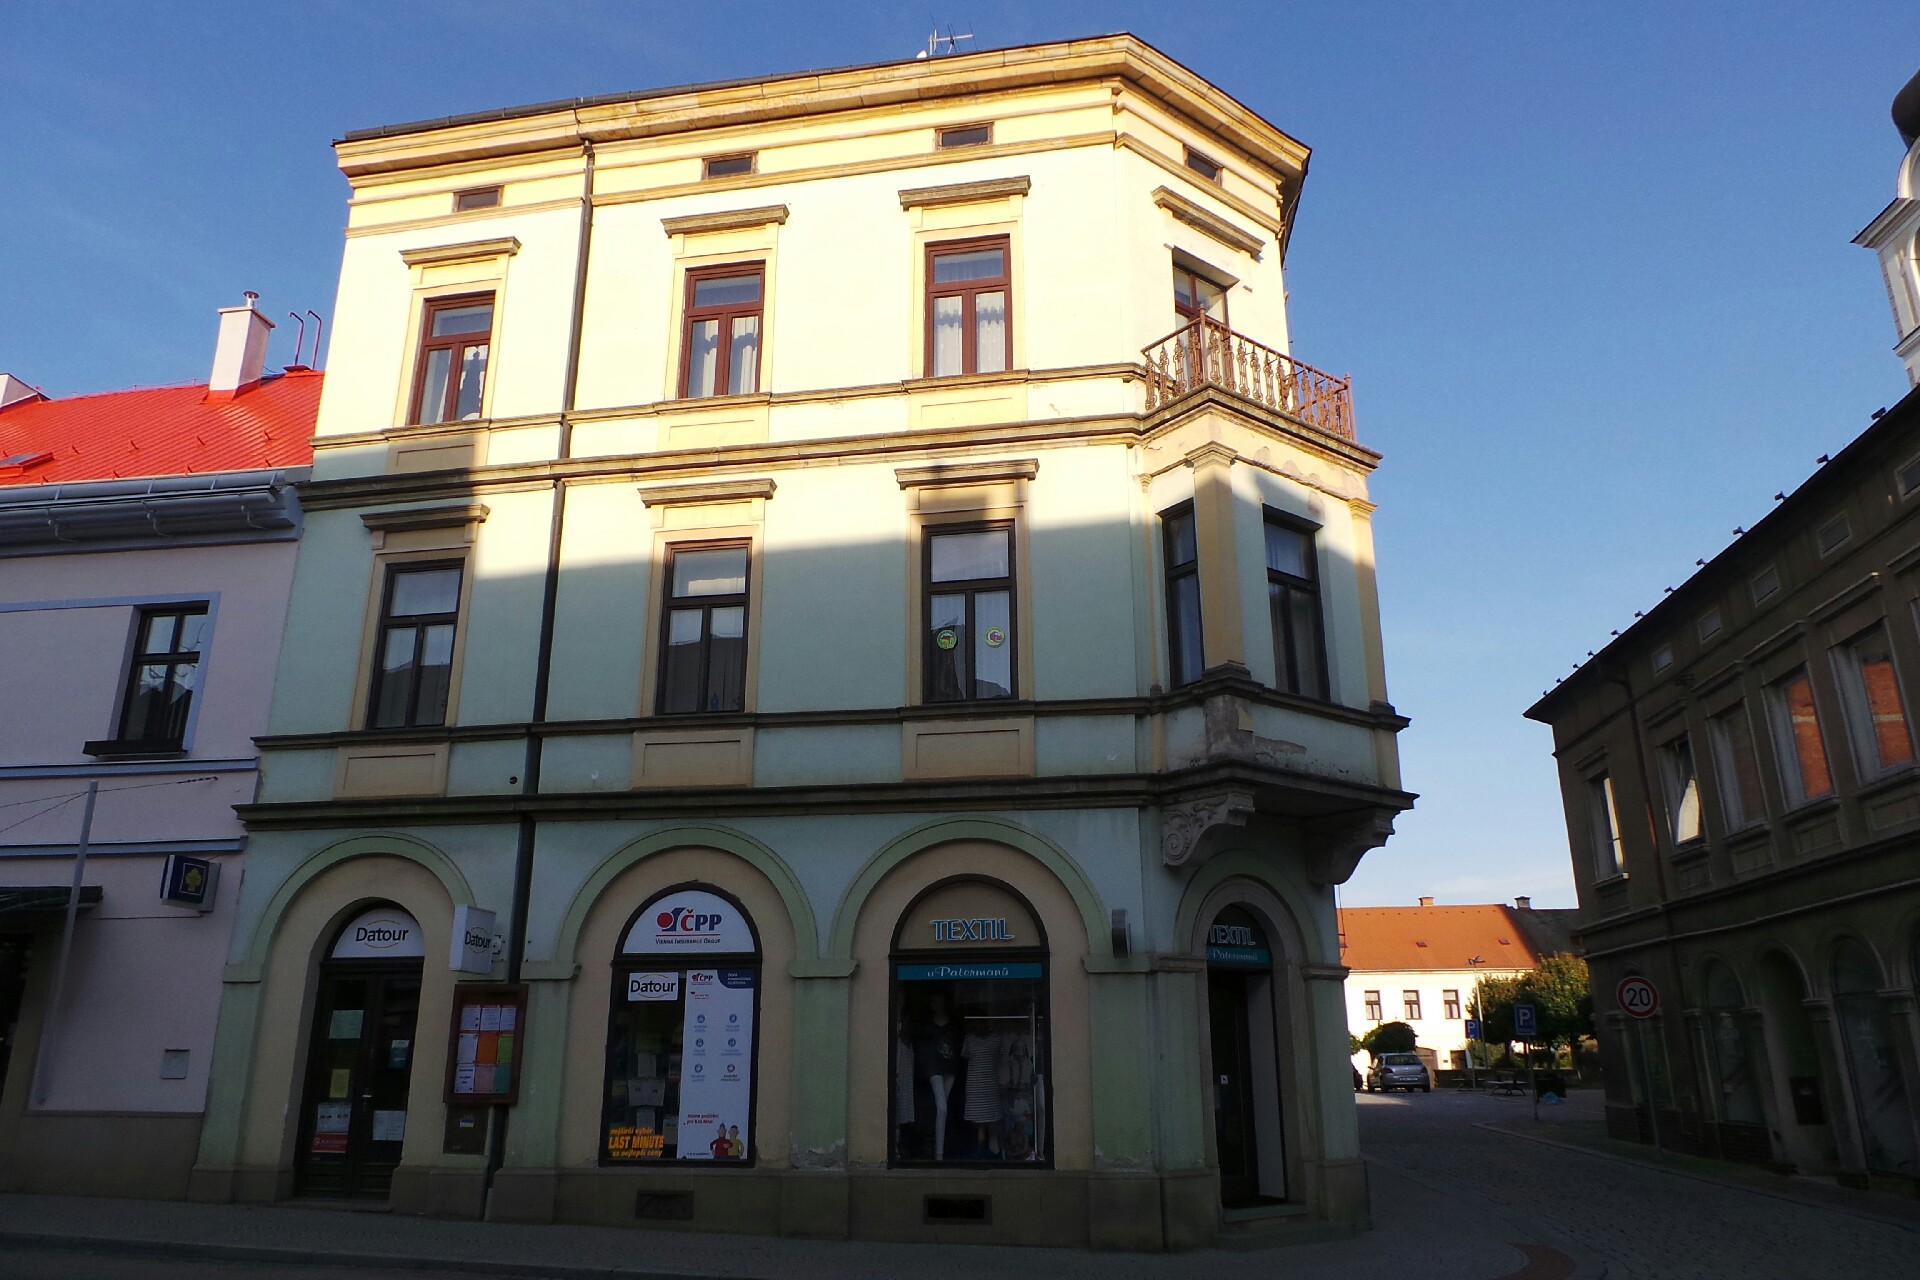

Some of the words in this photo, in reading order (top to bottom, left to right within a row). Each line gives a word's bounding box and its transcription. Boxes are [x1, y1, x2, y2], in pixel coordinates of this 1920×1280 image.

[681, 909, 722, 932] ČPP
[356, 928, 409, 942] Datour
[930, 918, 1015, 941] TEXTIL
[1210, 925, 1257, 946] TEXTIL
[465, 931, 491, 948] Datour
[631, 980, 677, 993] Datour
[1627, 987, 1651, 1006] 20
[1518, 1008, 1531, 1026] P
[1467, 1021, 1476, 1033] P
[608, 1136, 631, 1149] LAST
[632, 1135, 665, 1149] MINUTE
